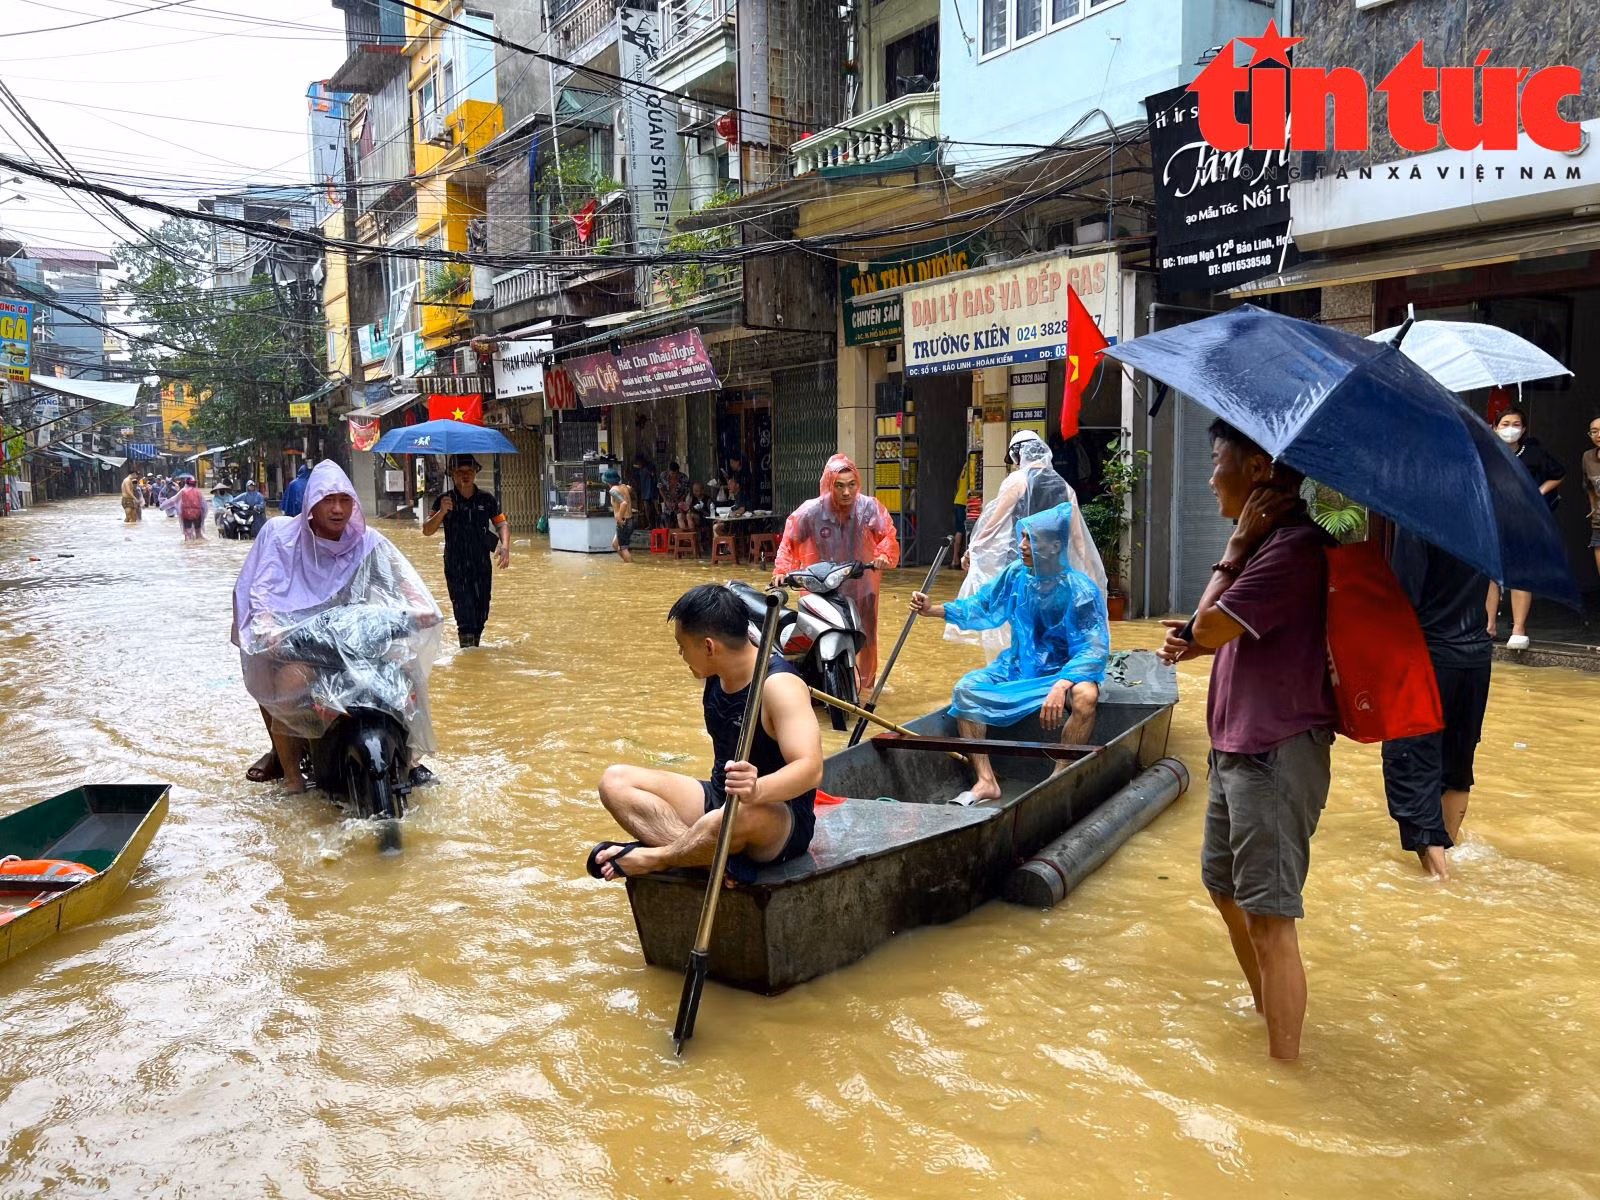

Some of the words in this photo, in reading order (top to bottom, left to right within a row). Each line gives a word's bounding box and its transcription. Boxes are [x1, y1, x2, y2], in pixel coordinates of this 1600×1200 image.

[645, 94, 665, 151] QUÁN
[1155, 107, 1186, 129] Hir
[651, 155, 670, 224] STREET
[1220, 202, 1239, 215] Tóc
[1242, 184, 1272, 211] Nối
[1177, 253, 1198, 266] Trong
[911, 297, 937, 331] ĐẠI
[940, 287, 958, 323] LÝ
[962, 285, 995, 319] GAS
[999, 274, 1022, 311] VÀ
[1026, 262, 1062, 307] BẾP
[1067, 261, 1105, 296] GAS
[912, 331, 970, 360] TRƯỜNG
[973, 322, 1010, 351] KIÊN
[1017, 325, 1037, 342] 024
[1040, 319, 1068, 337] 3828
[617, 358, 632, 371] Hát
[632, 356, 648, 368] Cho
[930, 366, 938, 374] 16
[956, 361, 971, 370] LINH
[976, 357, 995, 367] HOÀN
